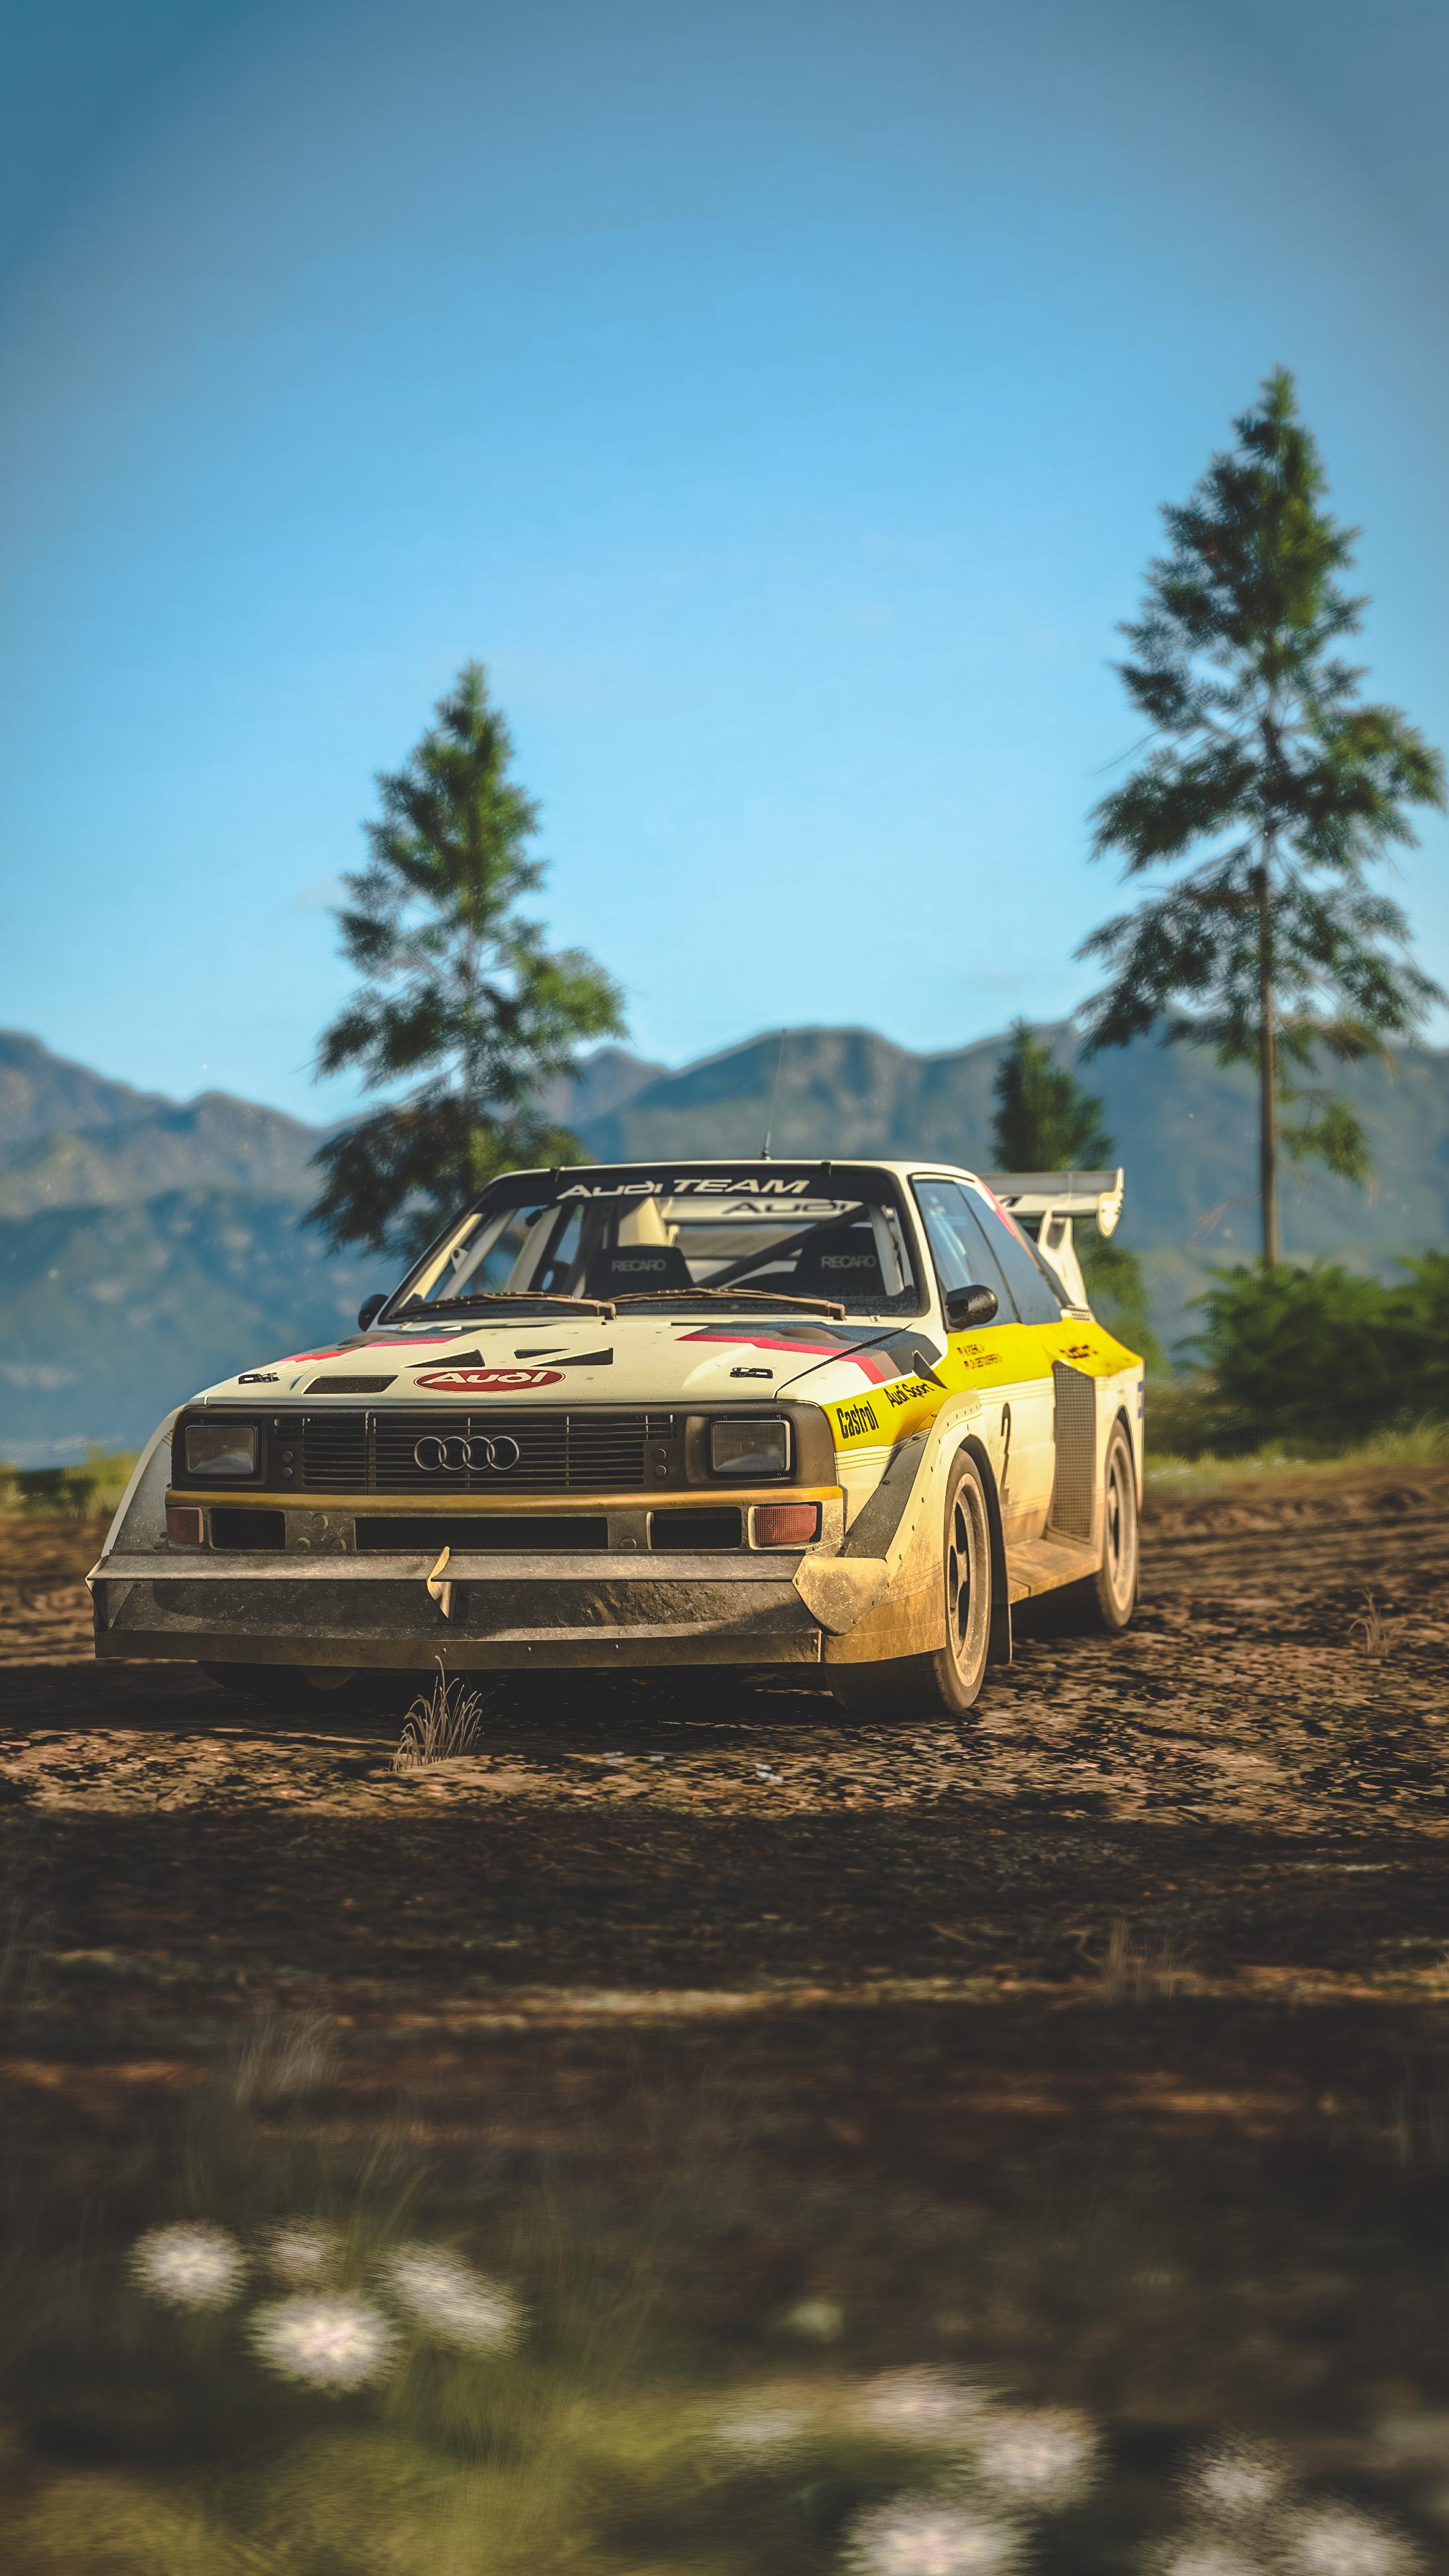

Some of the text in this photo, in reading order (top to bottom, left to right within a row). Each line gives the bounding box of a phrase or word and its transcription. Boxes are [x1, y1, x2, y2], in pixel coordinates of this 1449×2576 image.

[557, 1179, 810, 1199] AUDI TEAM
[612, 1260, 666, 1271] RECARO
[821, 1255, 876, 1268] RECARO
[421, 1371, 549, 1385] AUDI
[883, 1383, 935, 1407] Audi Sport
[836, 1400, 879, 1439] Castrol
